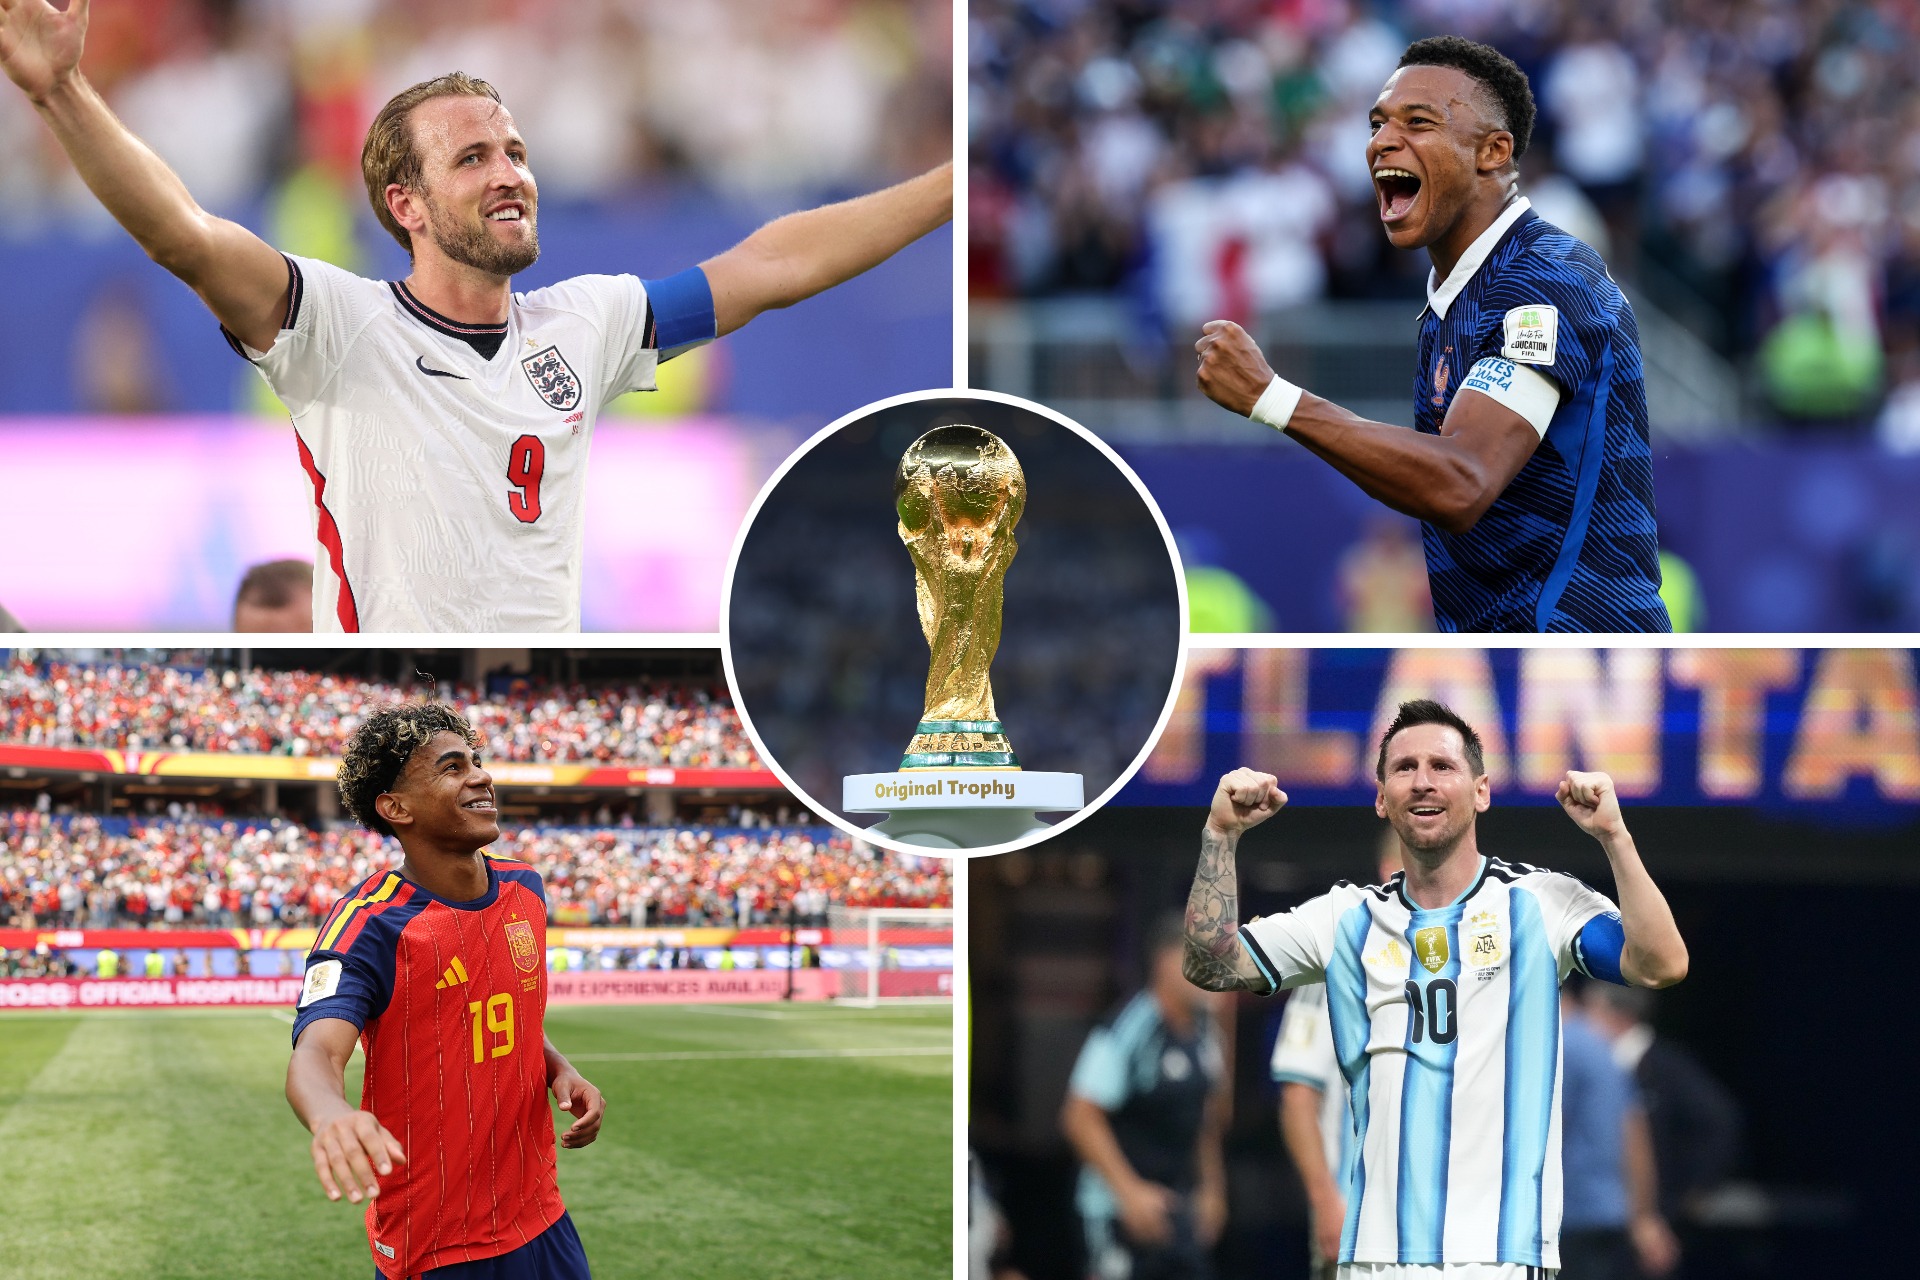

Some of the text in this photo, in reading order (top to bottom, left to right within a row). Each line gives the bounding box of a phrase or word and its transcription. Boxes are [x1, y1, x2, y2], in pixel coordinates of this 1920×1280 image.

[1511, 340, 1548, 351] EDUCATION
[1467, 379, 1489, 391] FIFA
[1475, 367, 1513, 391] World
[507, 434, 545, 523] 9
[950, 742, 983, 750] CUP
[875, 779, 1015, 801] Original Trophy
[1475, 934, 1496, 954] AFA
[80, 980, 175, 1005] OFFICIAL
[1405, 978, 1458, 1045] 10
[469, 993, 515, 1064] 19
